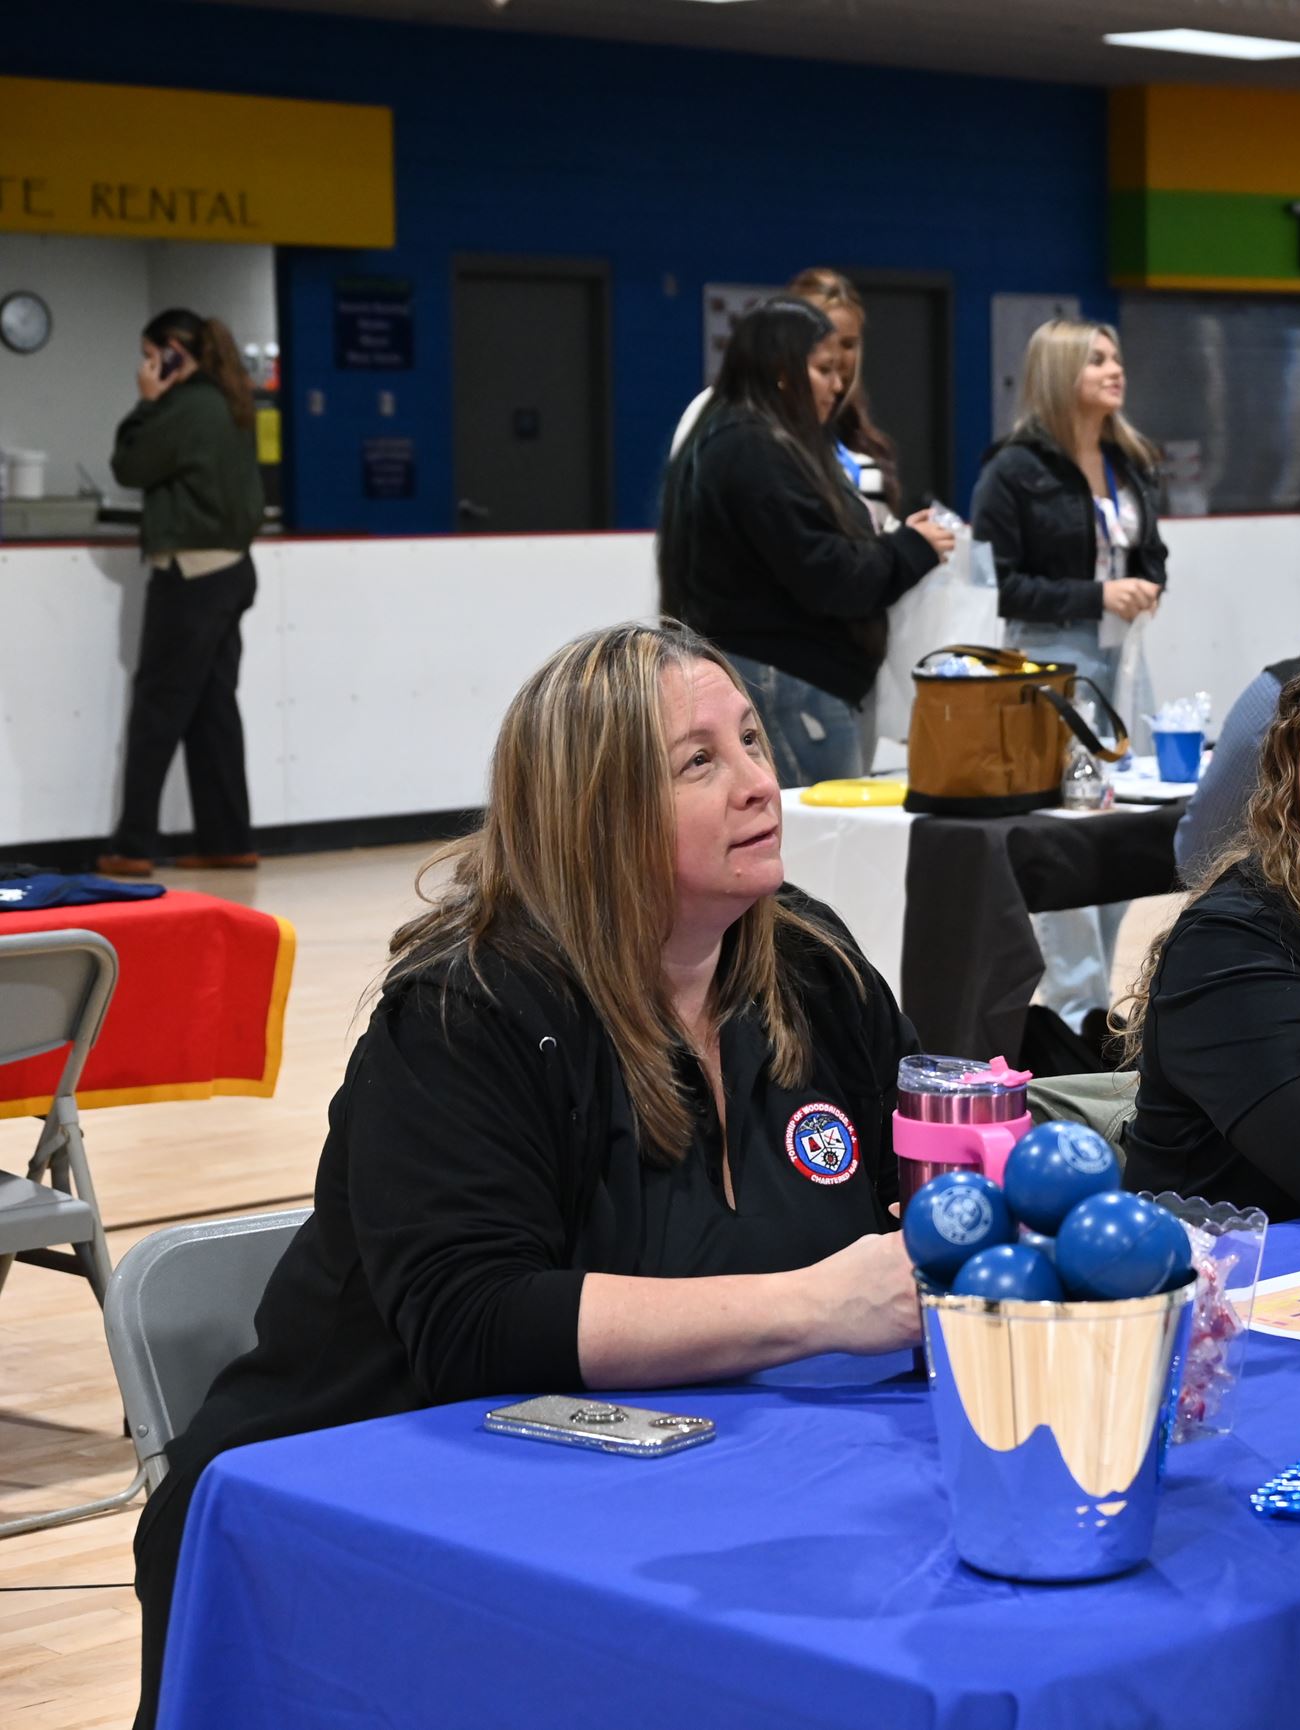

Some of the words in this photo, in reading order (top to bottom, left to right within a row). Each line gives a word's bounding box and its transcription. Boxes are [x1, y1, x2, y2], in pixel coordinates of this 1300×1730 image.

[90, 181, 260, 228] RENTAL
[785, 1120, 798, 1163] TOWNSHIP
[793, 1110, 804, 1122] OF
[810, 1172, 850, 1185] CHARTERED
